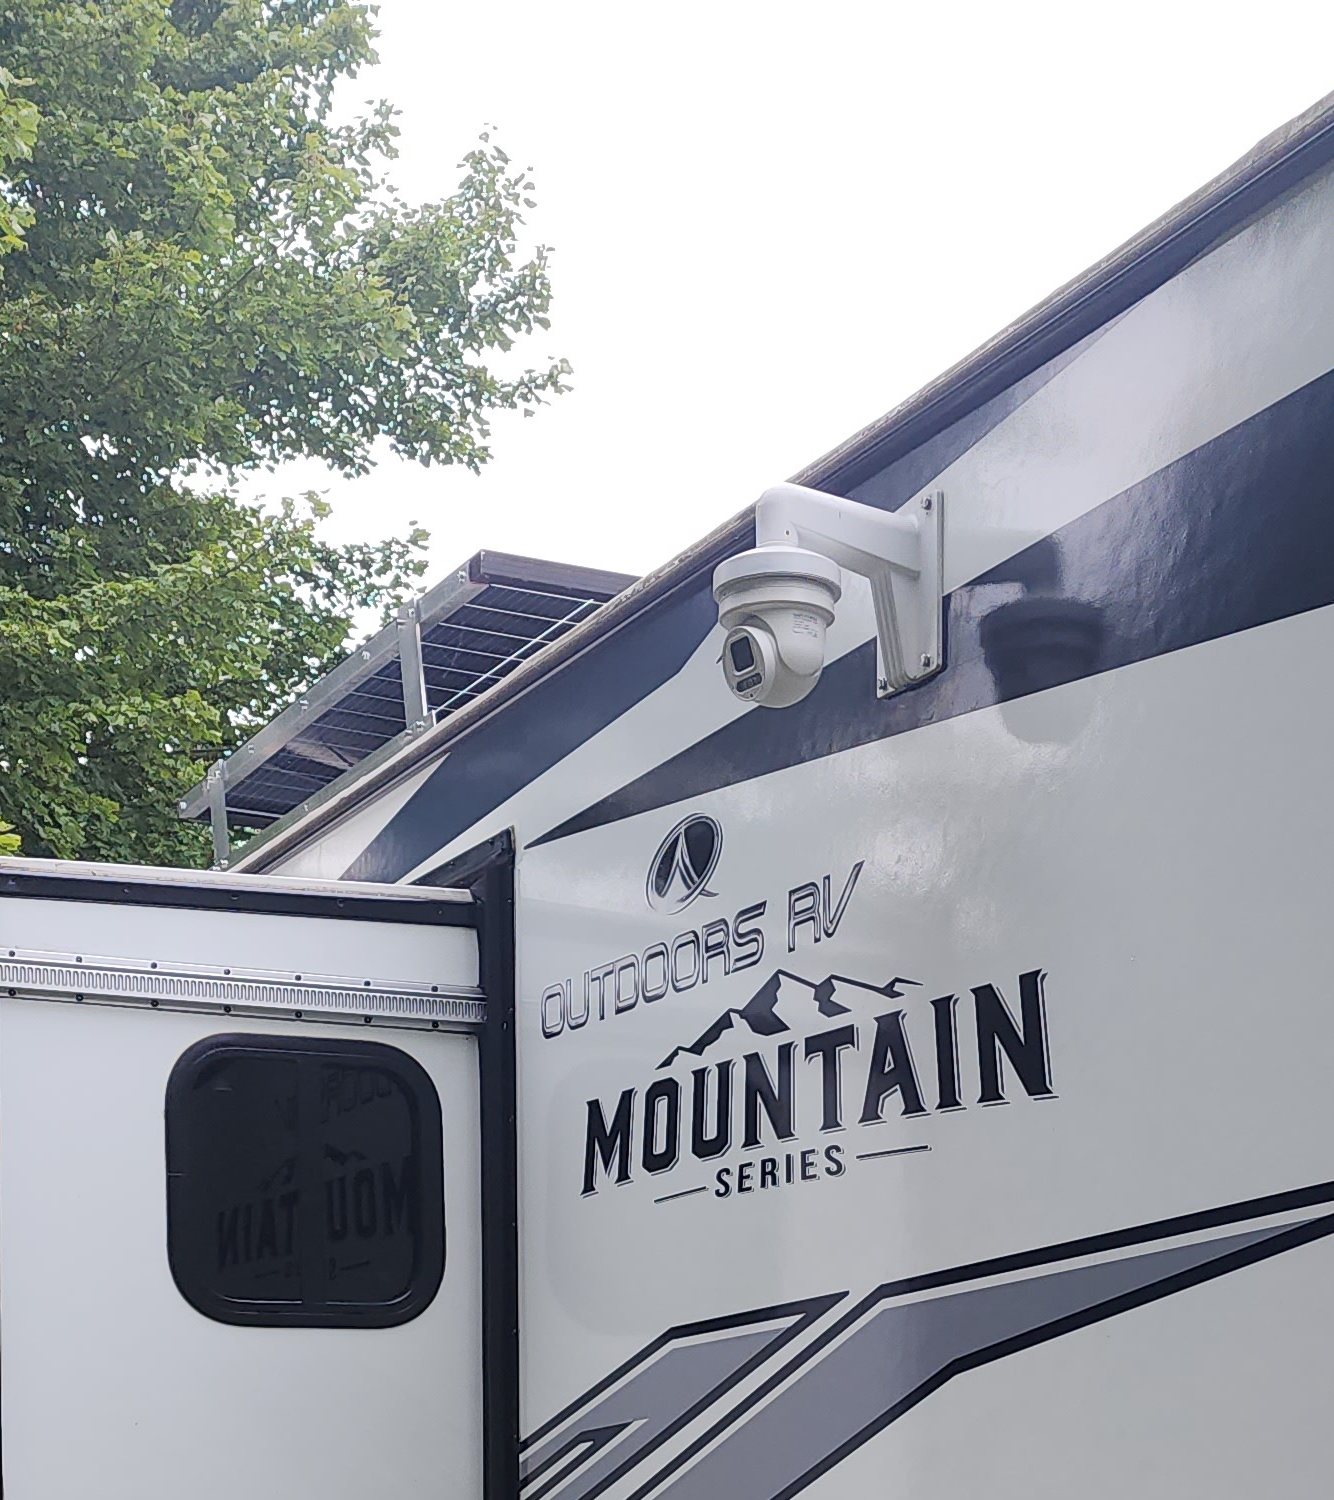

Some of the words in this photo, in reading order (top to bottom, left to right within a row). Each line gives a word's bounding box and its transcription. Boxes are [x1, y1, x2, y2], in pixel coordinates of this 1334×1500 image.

[540, 900, 767, 1040] OUTDOORS
[787, 860, 865, 953] RV
[580, 968, 1059, 1199] MOUNTAIN
[713, 1144, 848, 1200] SERIES
